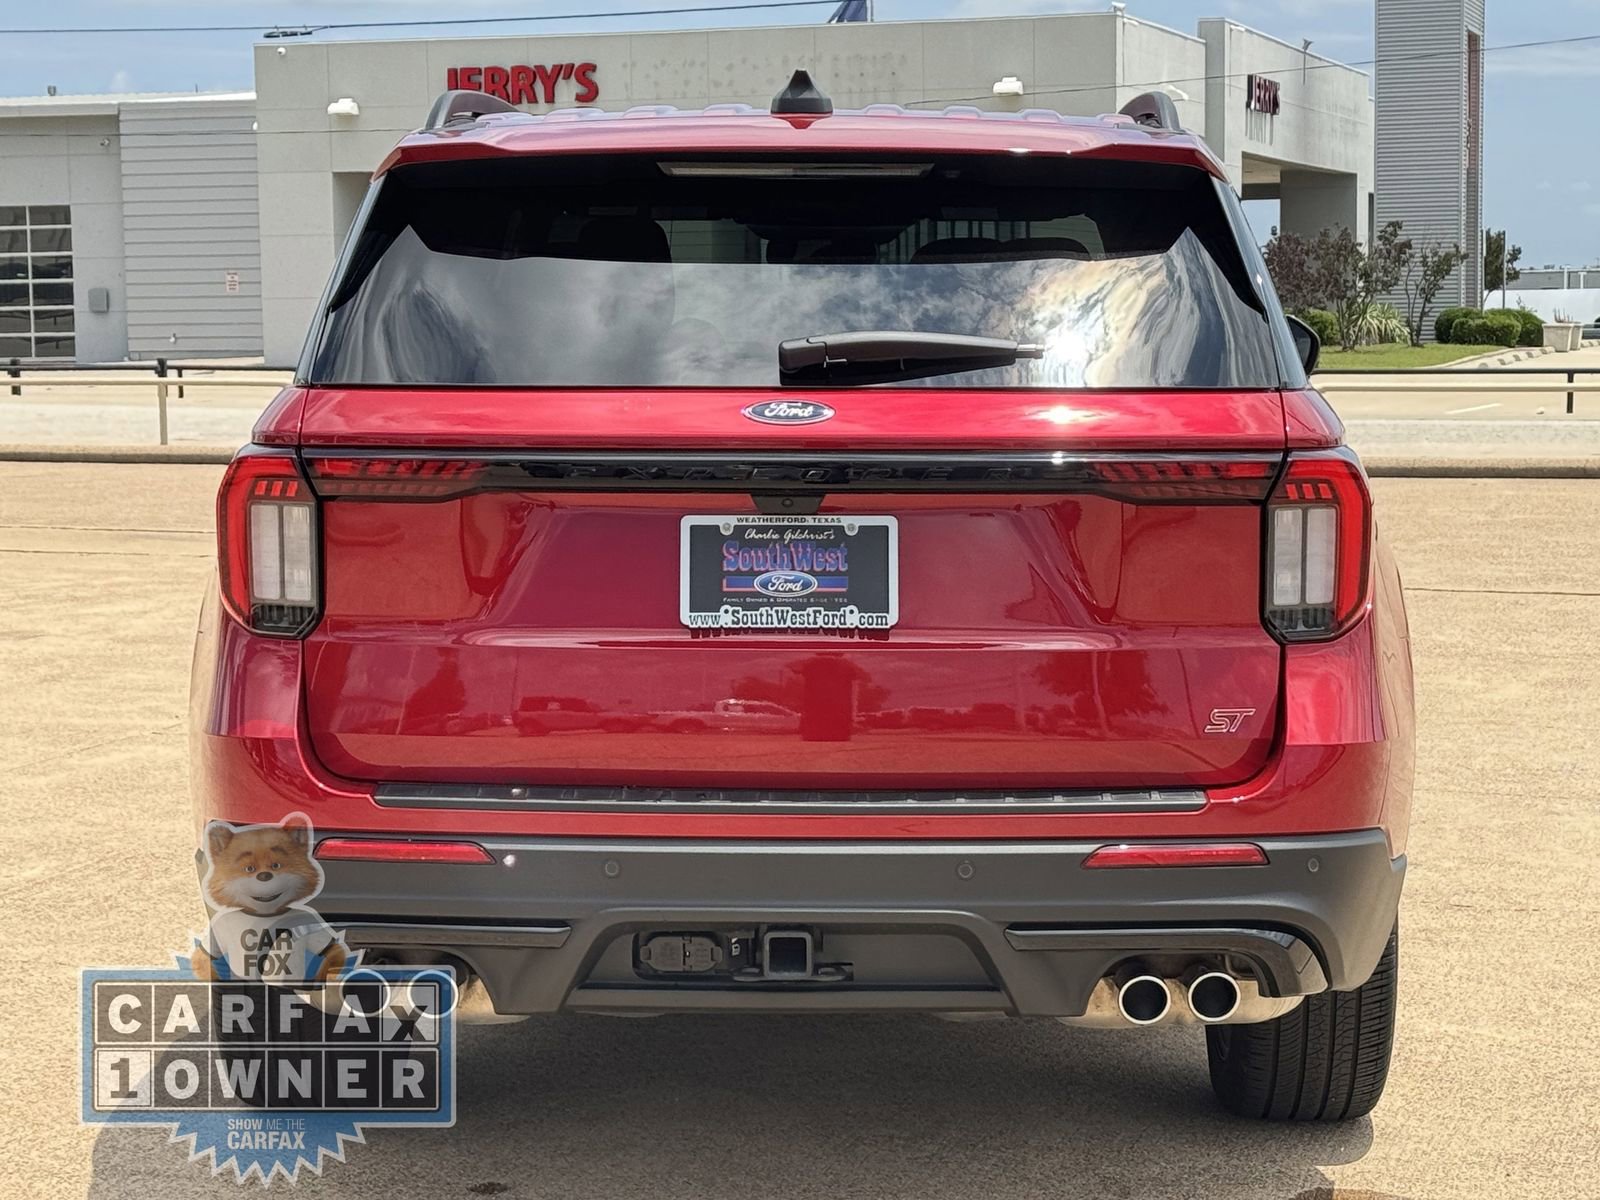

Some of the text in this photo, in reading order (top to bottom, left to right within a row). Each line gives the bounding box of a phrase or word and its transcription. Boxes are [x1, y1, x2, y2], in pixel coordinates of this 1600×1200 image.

[763, 402, 814, 417] Ford
[722, 540, 848, 572] SouthWest
[767, 575, 803, 592] Ford
[1204, 708, 1256, 733] ST
